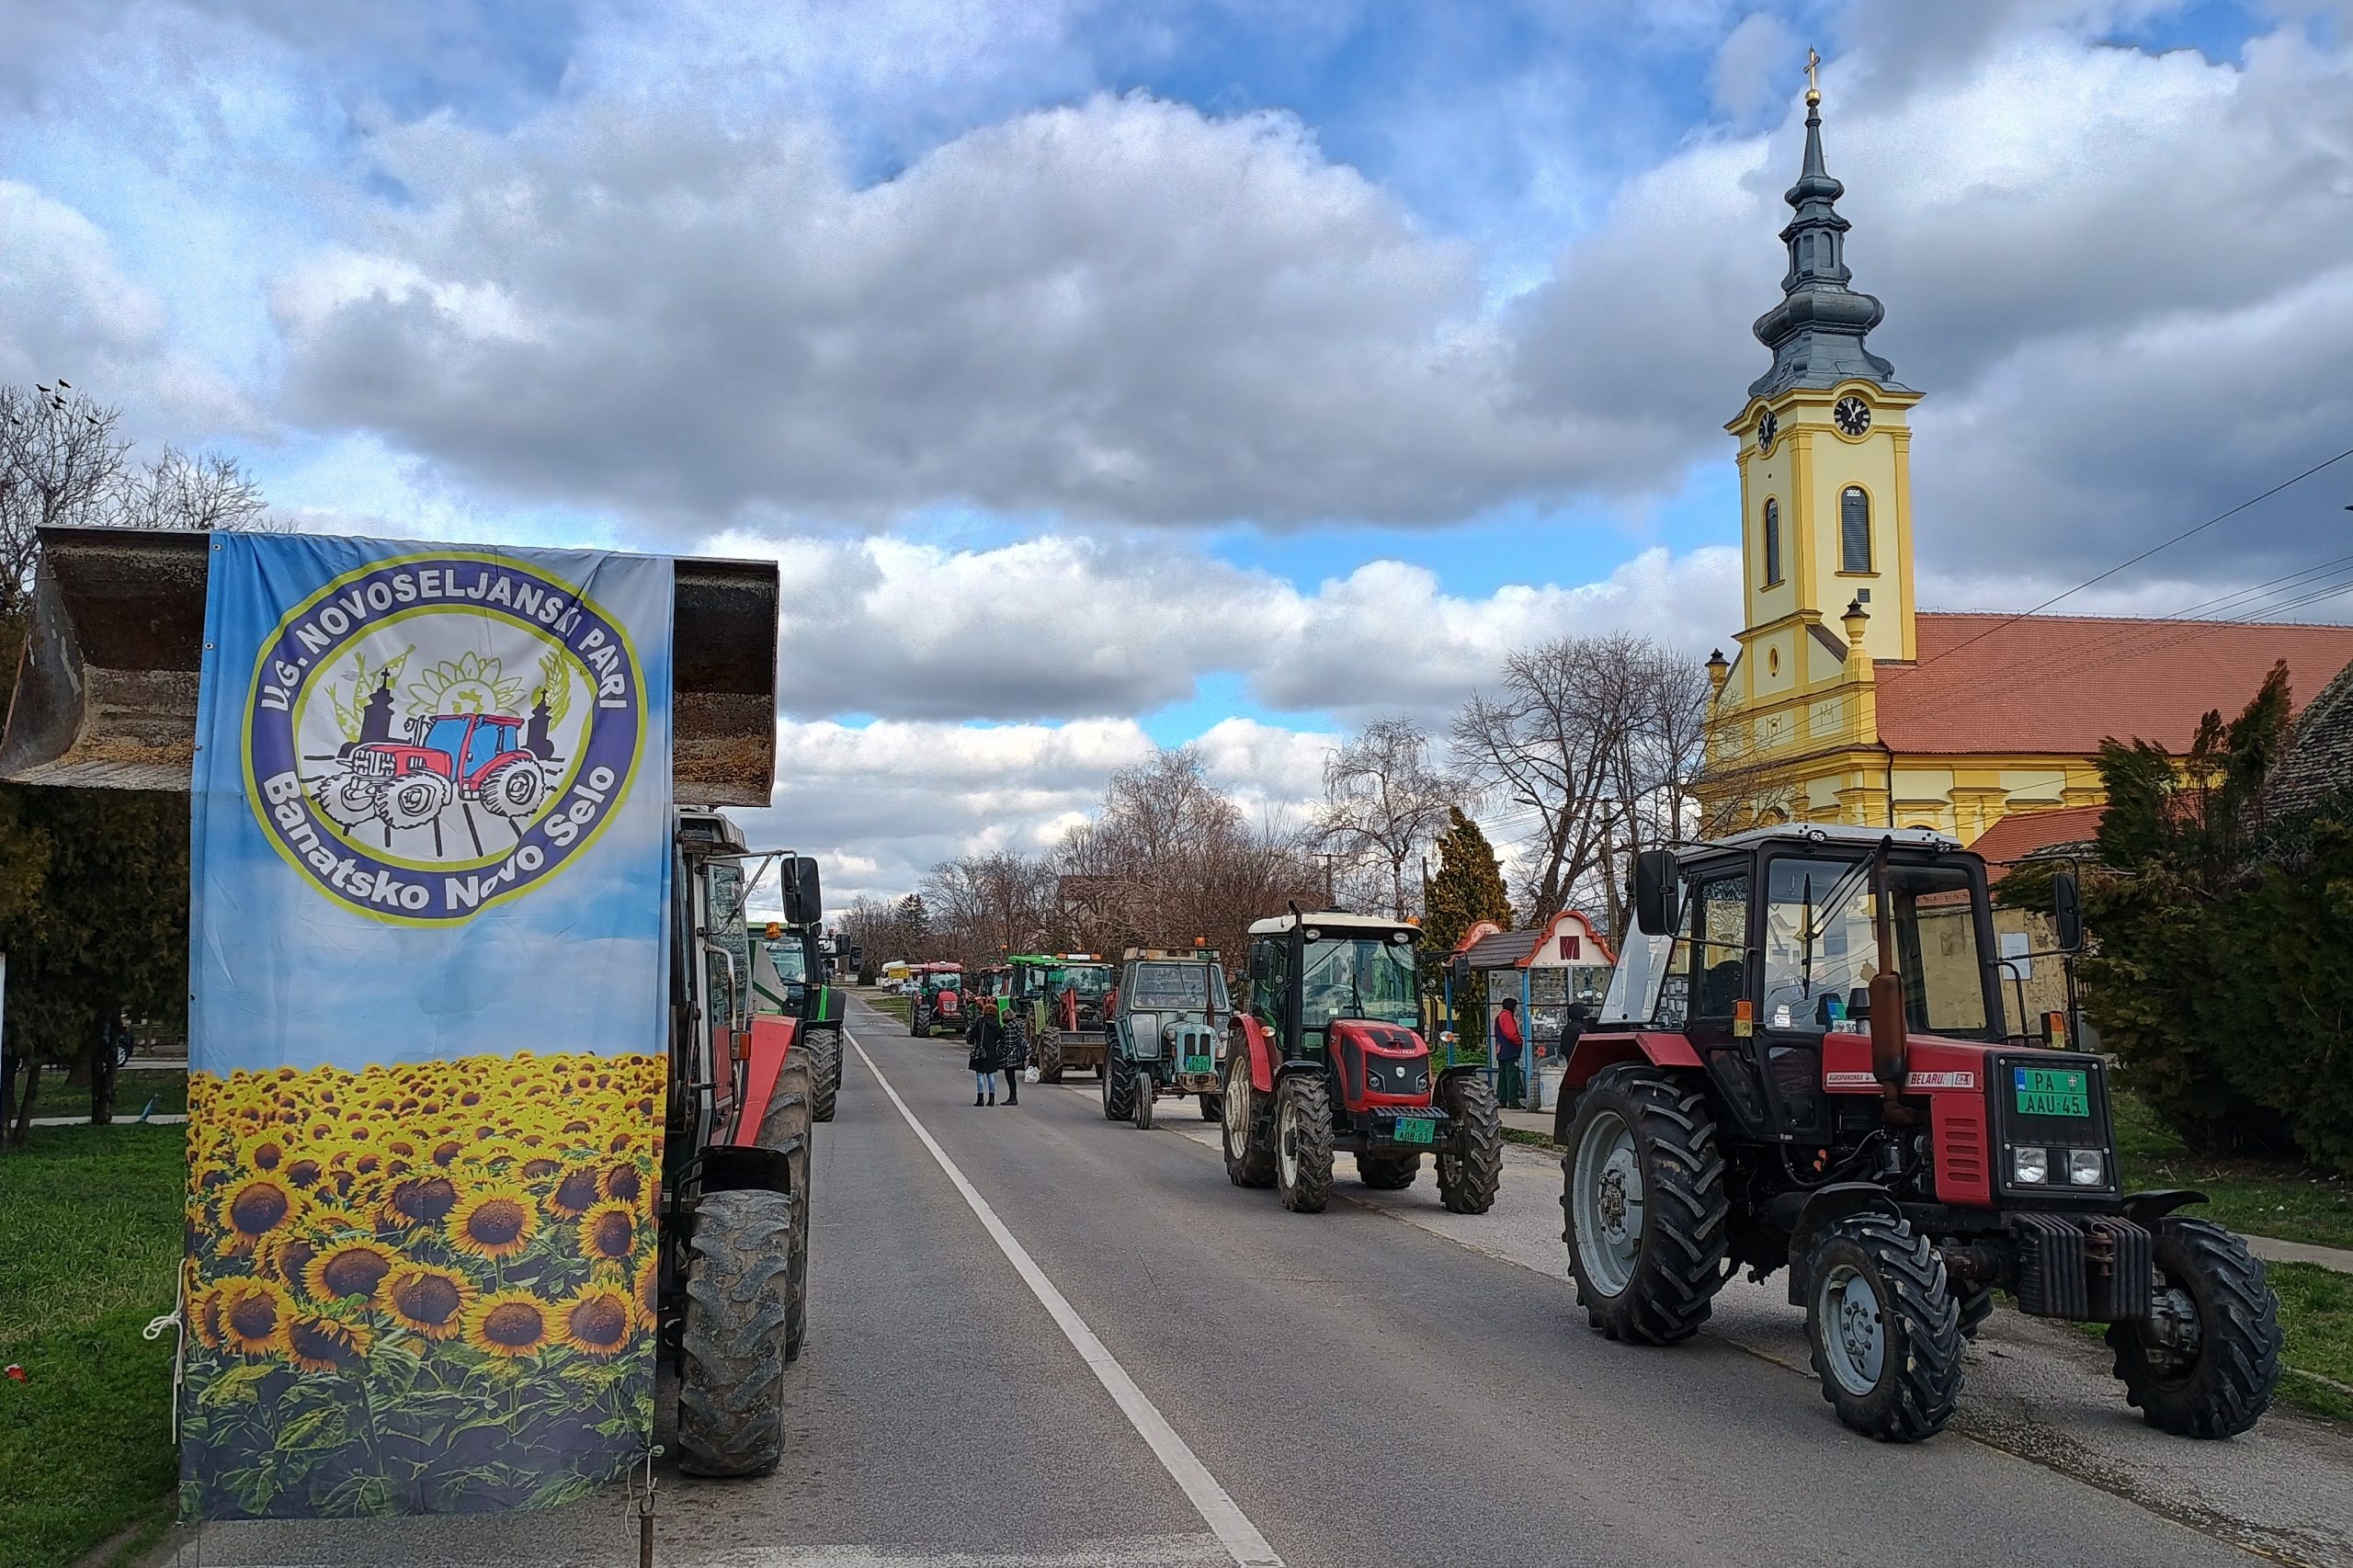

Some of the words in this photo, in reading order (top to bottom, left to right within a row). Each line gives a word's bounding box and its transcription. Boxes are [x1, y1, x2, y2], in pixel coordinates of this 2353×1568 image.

[296, 569, 583, 654] NOVOSELJANSKI
[263, 770, 430, 910] Banatsko
[445, 845, 544, 910] Novo
[544, 765, 615, 846] Selo
[1910, 1073, 1948, 1085] BELARU
[2034, 1072, 2055, 1091] PA
[1406, 1120, 1416, 1131] PA
